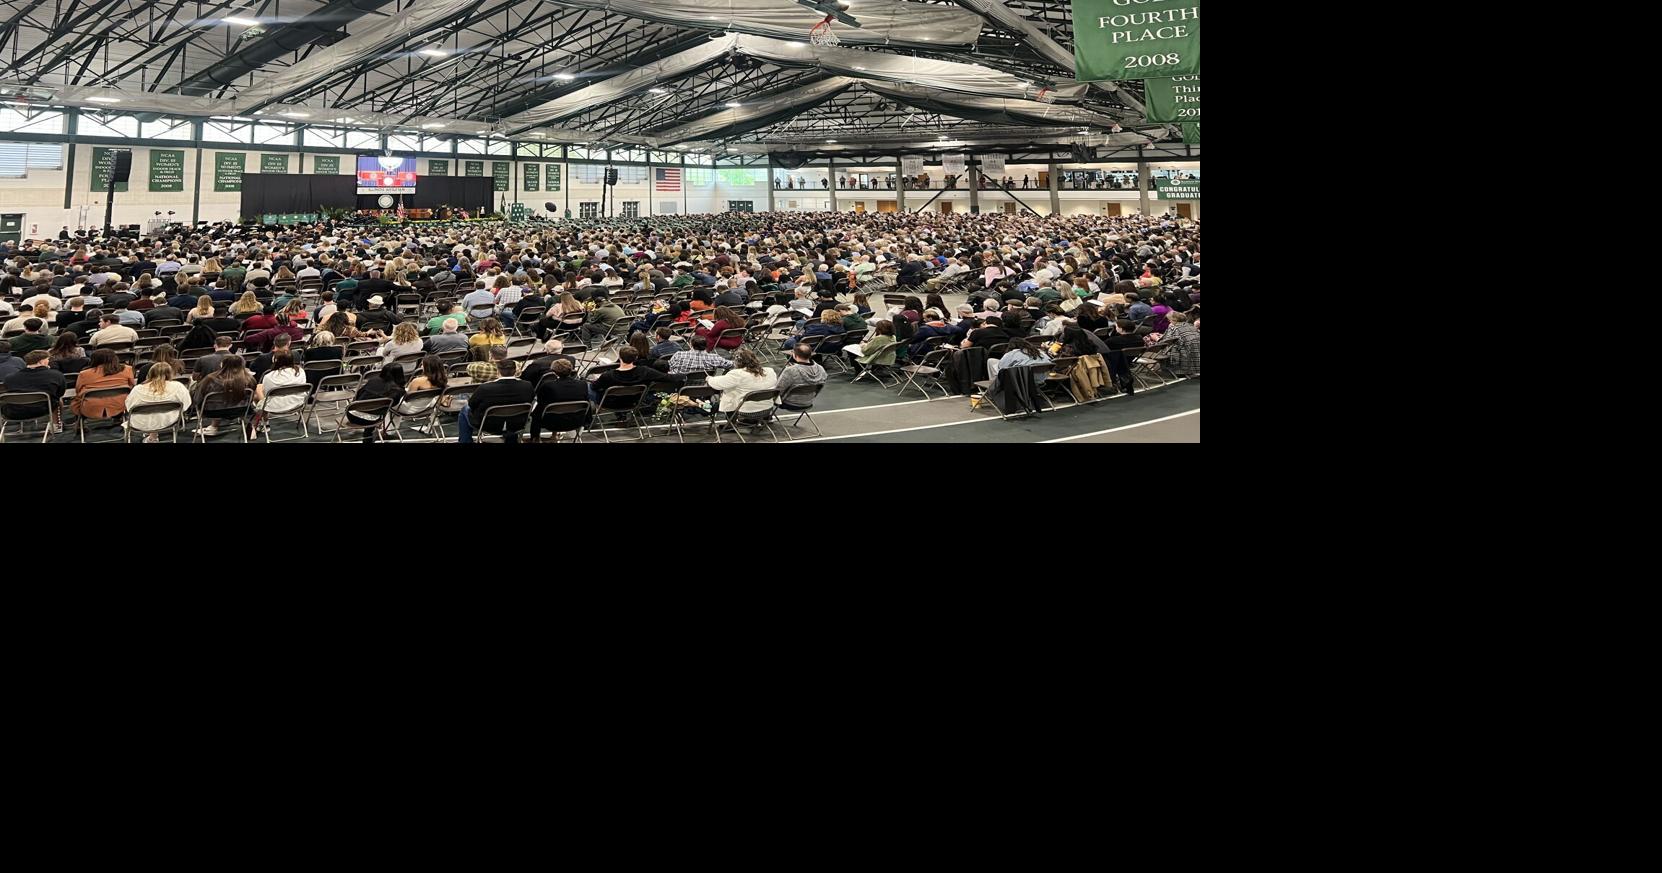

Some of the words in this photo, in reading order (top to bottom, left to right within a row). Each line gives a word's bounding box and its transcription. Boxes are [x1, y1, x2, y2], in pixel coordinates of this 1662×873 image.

[1098, 7, 1199, 28] FOURTH
[1111, 25, 1188, 43] PLACE
[1124, 53, 1180, 69] 2008
